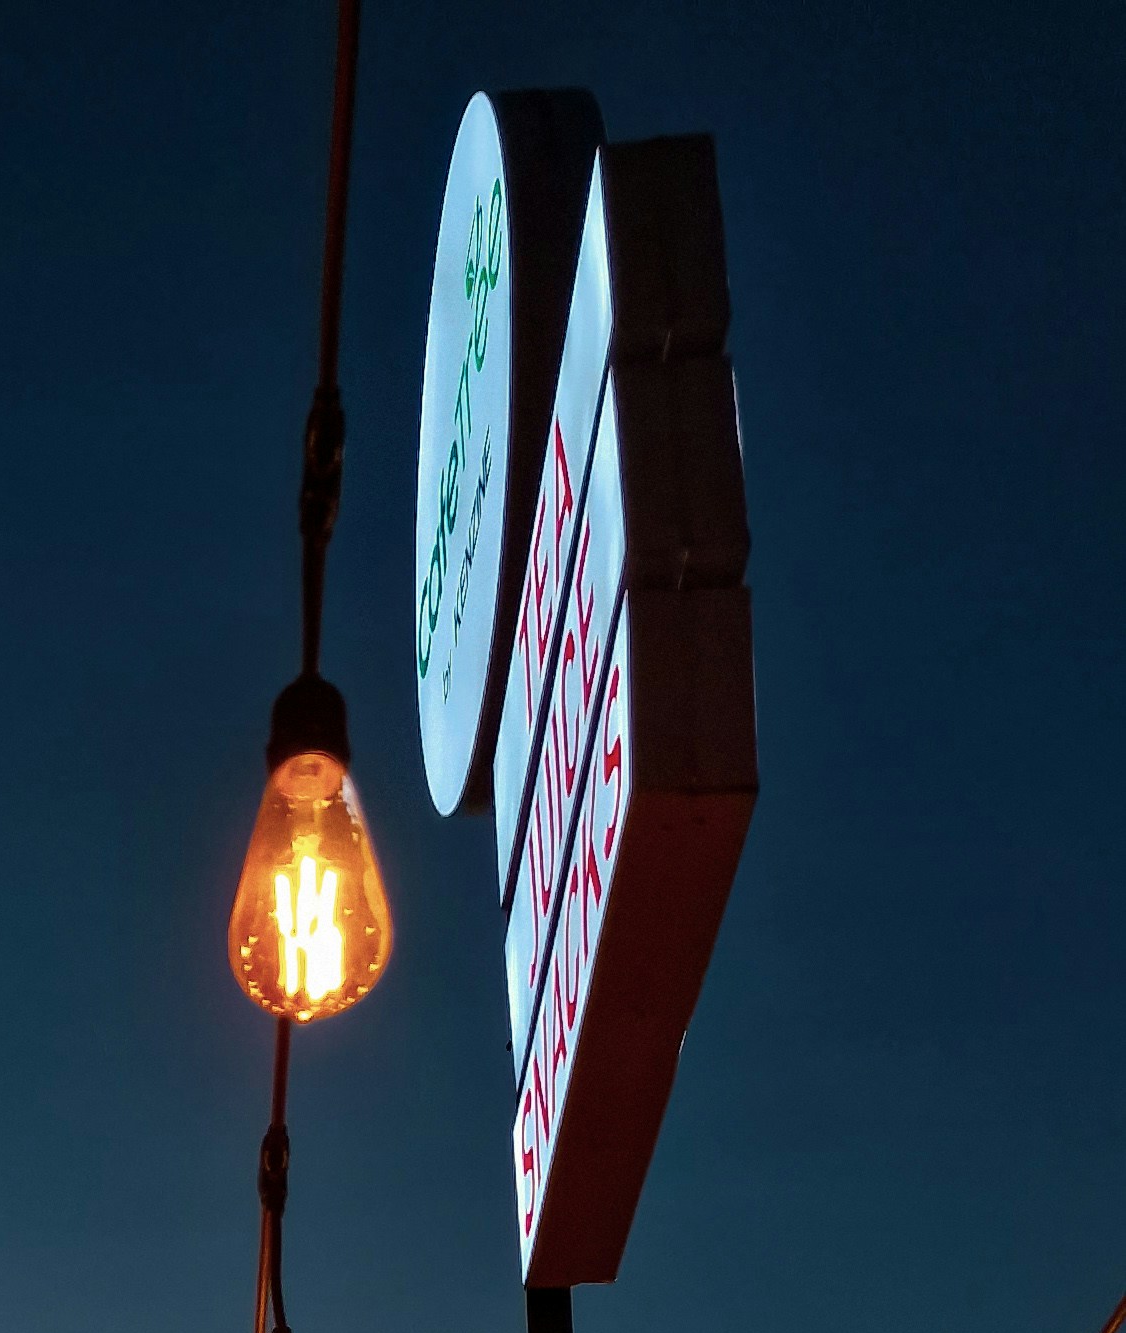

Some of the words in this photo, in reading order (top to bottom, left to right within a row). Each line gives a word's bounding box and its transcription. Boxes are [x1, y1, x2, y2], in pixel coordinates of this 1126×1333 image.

[453, 424, 492, 647] KENZINE
[518, 414, 574, 734] TEA
[527, 512, 600, 990] JUICE
[521, 664, 621, 1239] SNACKS
